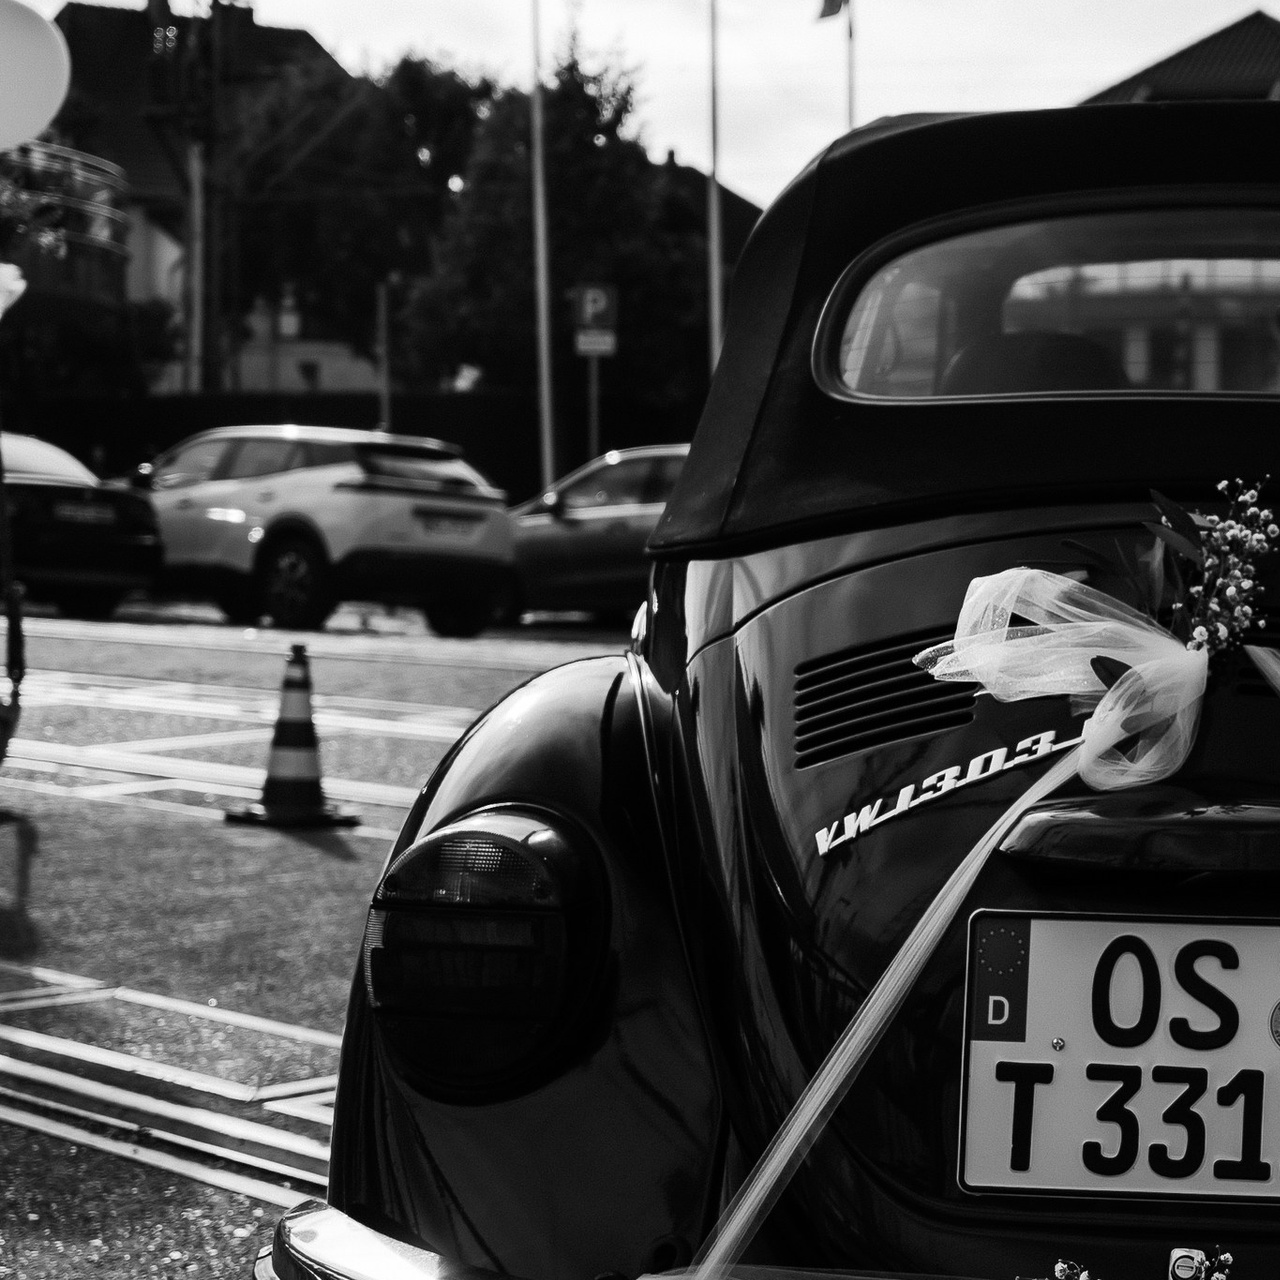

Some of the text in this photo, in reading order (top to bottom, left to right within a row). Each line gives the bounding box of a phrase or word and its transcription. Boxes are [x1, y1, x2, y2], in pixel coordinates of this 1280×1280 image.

[583, 287, 607, 323] P
[815, 730, 1056, 856] VW 1303
[987, 995, 1010, 1025] D
[1092, 934, 1240, 1050] OS
[995, 1061, 1054, 1171] T
